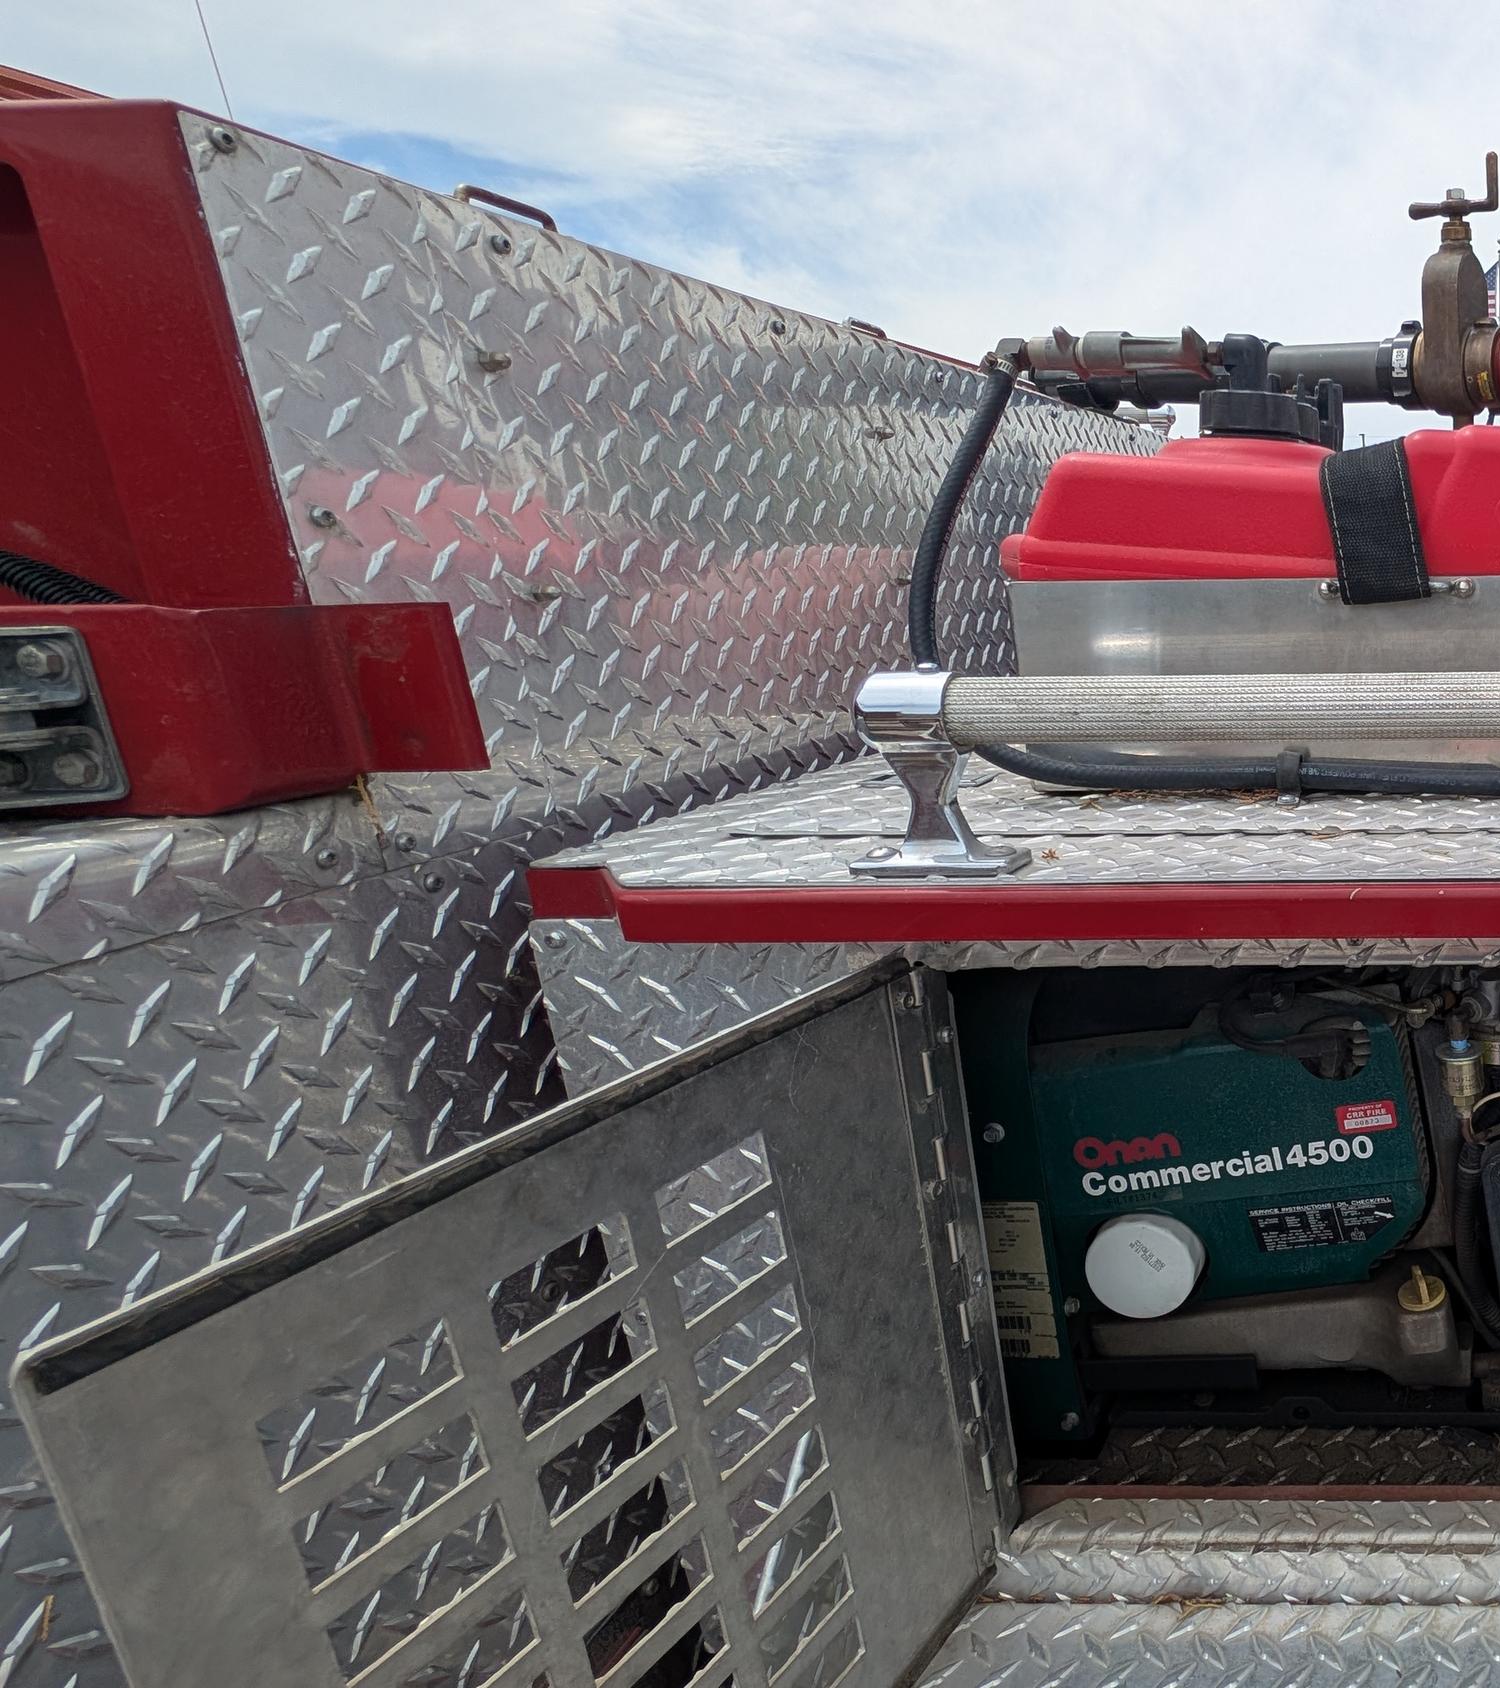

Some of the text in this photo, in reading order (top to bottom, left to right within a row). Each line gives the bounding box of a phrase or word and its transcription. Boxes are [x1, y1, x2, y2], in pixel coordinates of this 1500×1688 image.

[1366, 1108, 1387, 1117] FIRE
[1073, 1132, 1181, 1169] Onan
[1082, 1135, 1374, 1197] Commercial 4500
